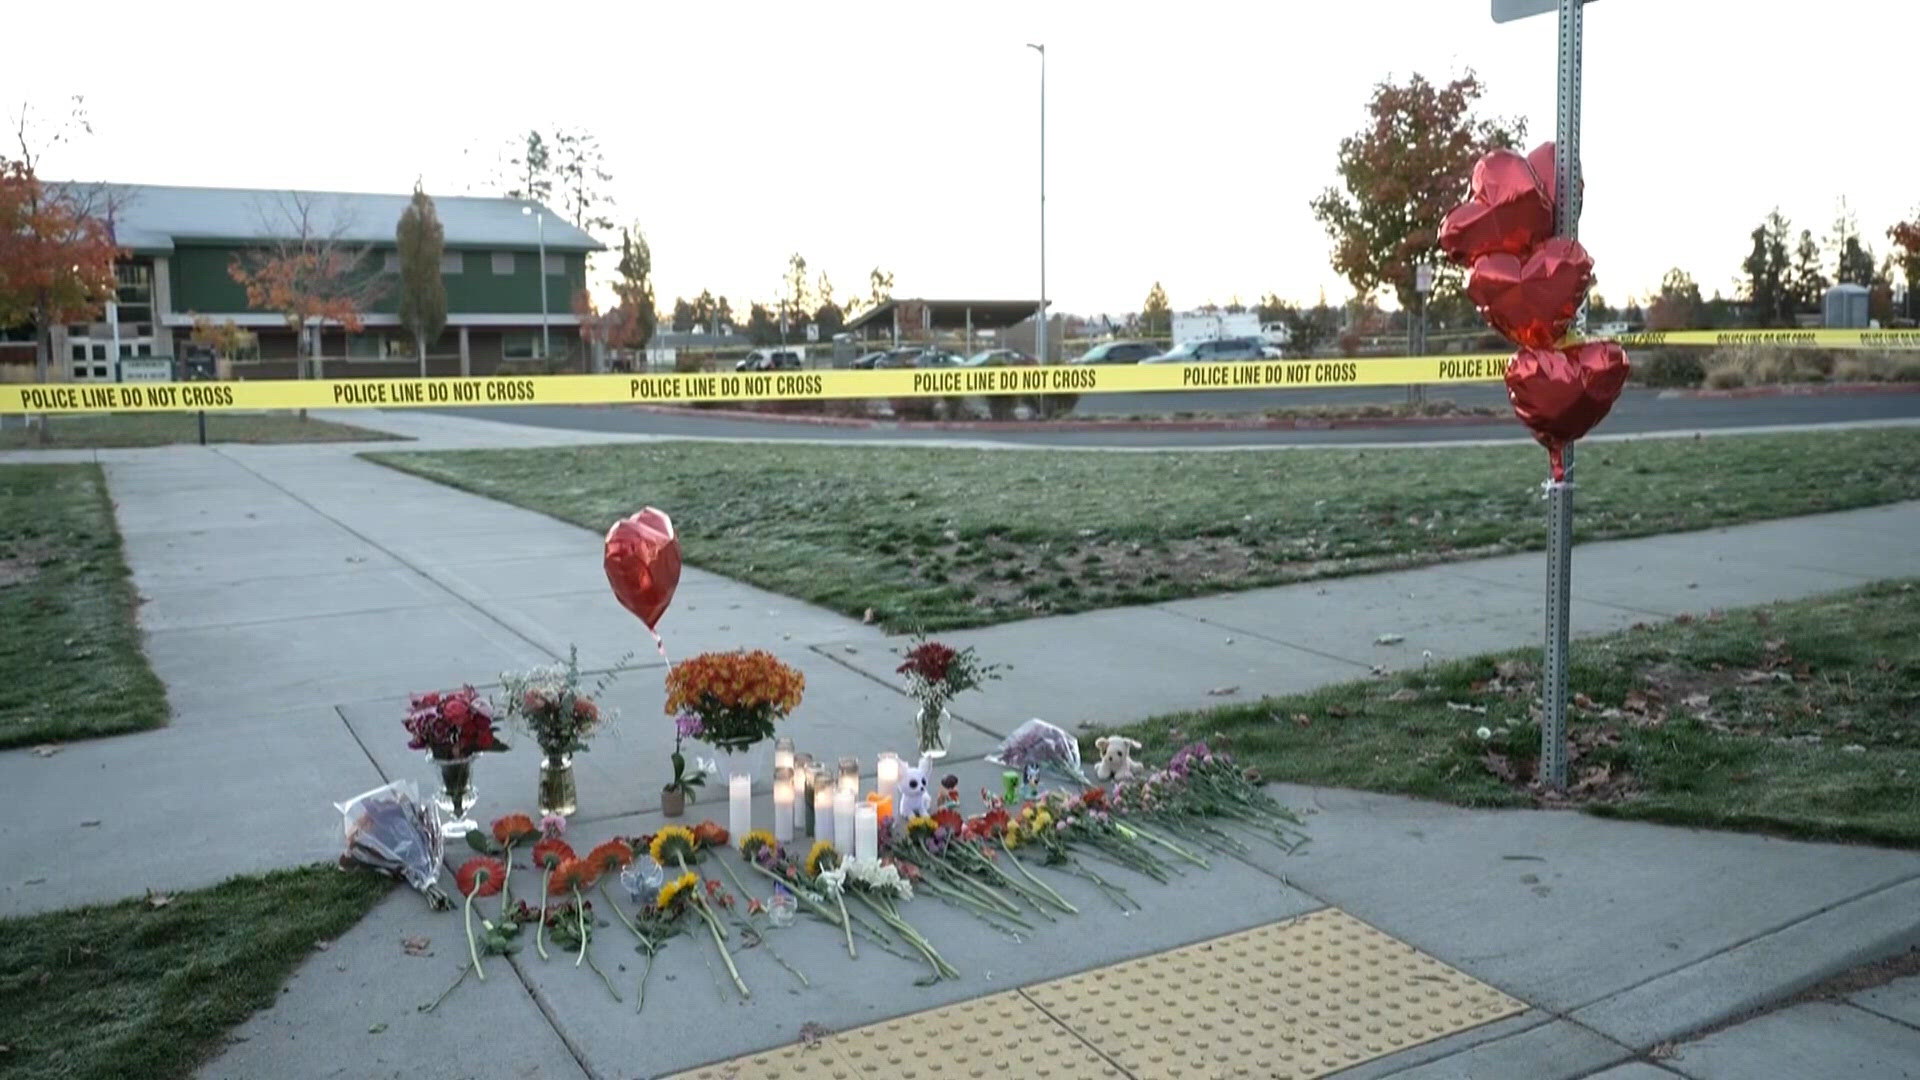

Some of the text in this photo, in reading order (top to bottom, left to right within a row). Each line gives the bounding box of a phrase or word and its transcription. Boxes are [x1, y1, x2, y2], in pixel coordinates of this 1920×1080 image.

[1183, 363, 1357, 385] POLICE LINE DO NOT CROSS
[1439, 358, 1508, 379] POLICE LIN
[333, 380, 535, 404] POLICE LINE DO NOT CROSS
[630, 375, 822, 398] POLICE LINE DO NOT CROSS
[914, 369, 1096, 392] POLICE LINE DO NOT CROSS
[20, 385, 234, 409] POLICE LINE DO NOT CROSS
